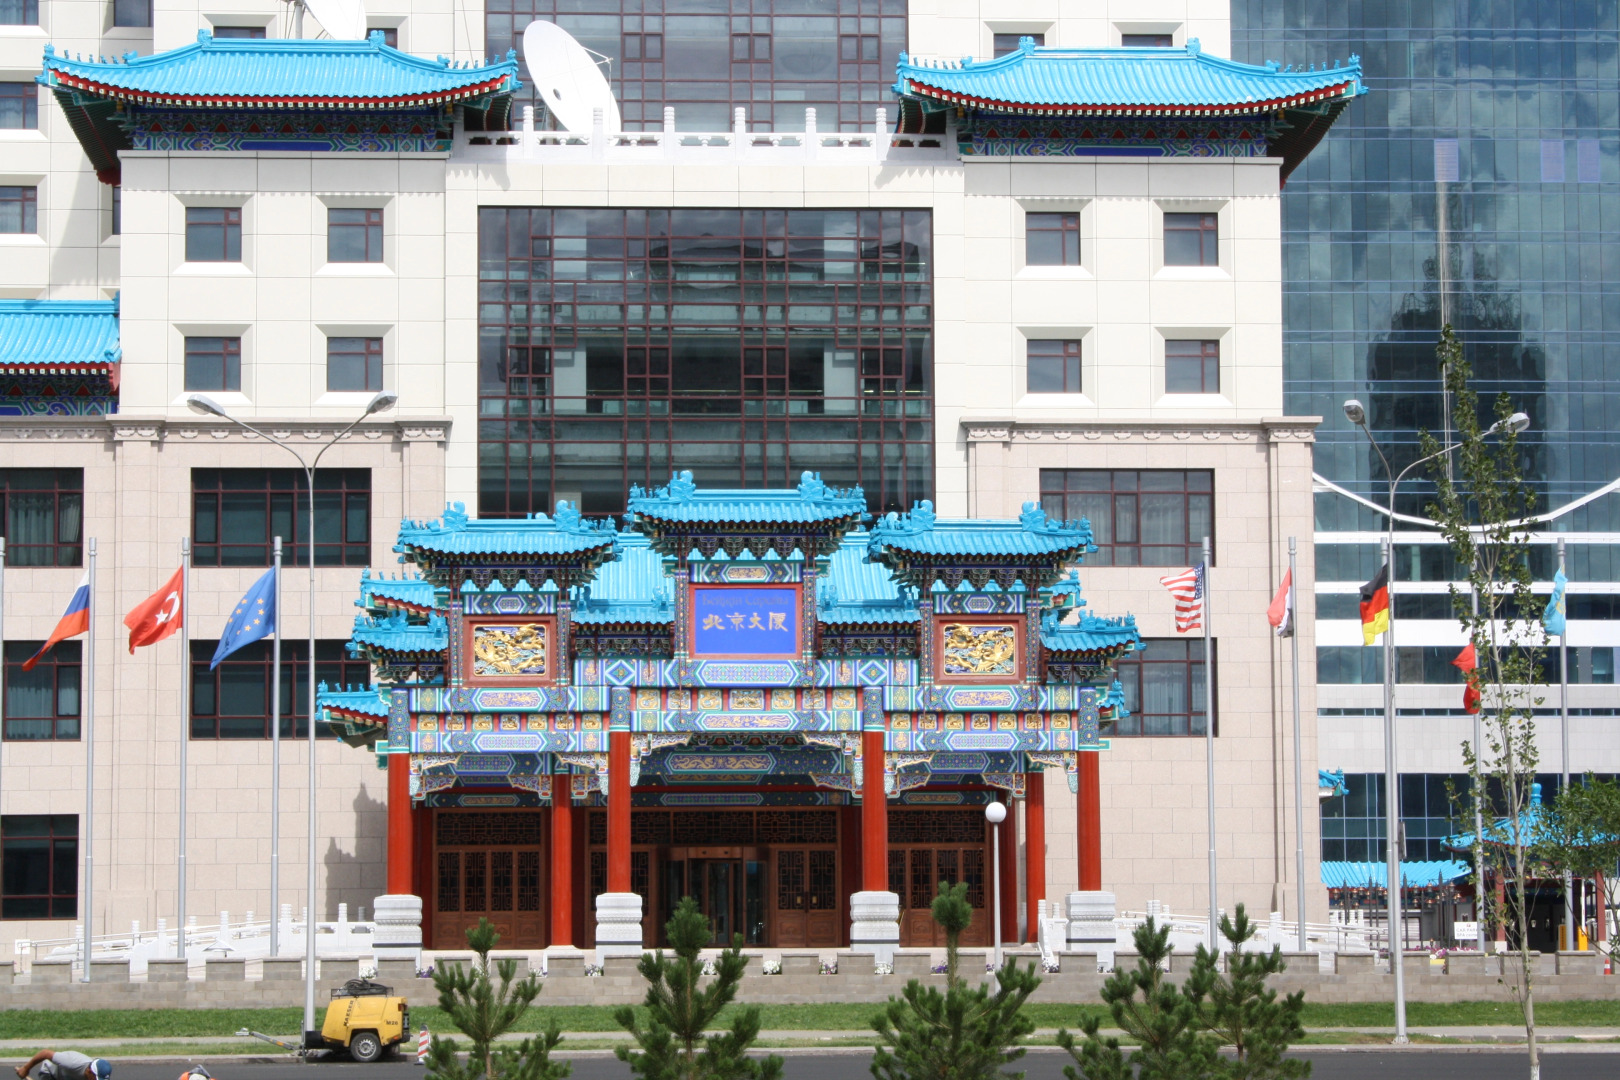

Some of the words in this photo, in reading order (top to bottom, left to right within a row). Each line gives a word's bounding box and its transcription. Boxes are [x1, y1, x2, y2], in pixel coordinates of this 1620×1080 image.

[703, 612, 788, 632] 北京大厦
[344, 1000, 354, 1026] KAESER
